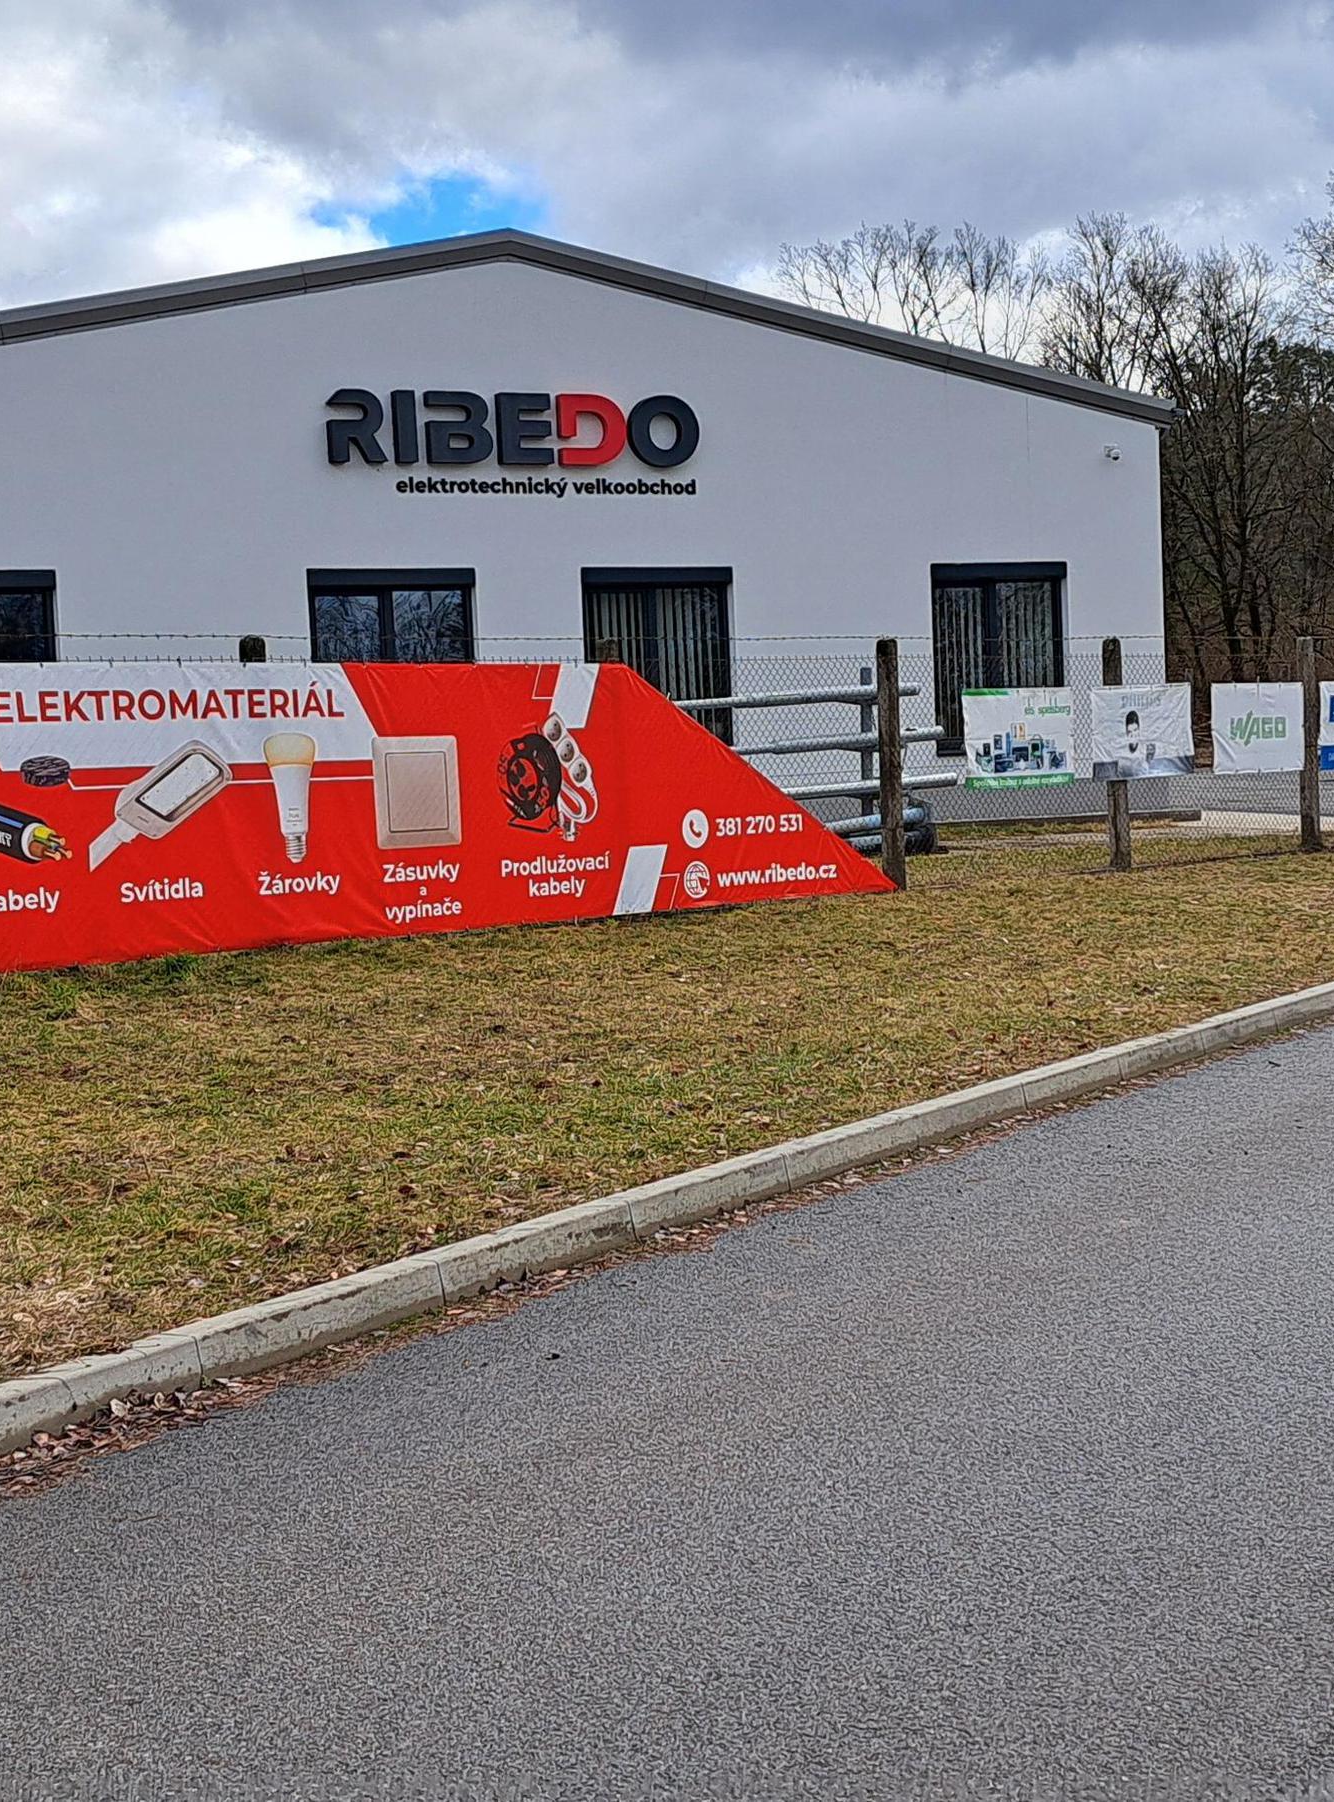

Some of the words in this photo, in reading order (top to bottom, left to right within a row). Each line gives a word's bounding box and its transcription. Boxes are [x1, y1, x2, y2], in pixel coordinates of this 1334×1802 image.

[325, 388, 700, 468] RIBEDO
[396, 476, 567, 498] elektrotechnický
[572, 478, 697, 496] velkoobchod
[1229, 713, 1287, 745] WAGO
[715, 817, 742, 837] 381
[745, 815, 775, 835] 270
[779, 813, 803, 832] 531
[383, 859, 461, 883] Zásuvky
[501, 851, 611, 878] Prodlužovací
[717, 862, 838, 888] www.ribedo.cz
[120, 877, 204, 903] Svítidla
[258, 871, 341, 896] Žárovky
[419, 885, 427, 896] a
[529, 876, 586, 897] kabely
[385, 897, 463, 924] vypínače
